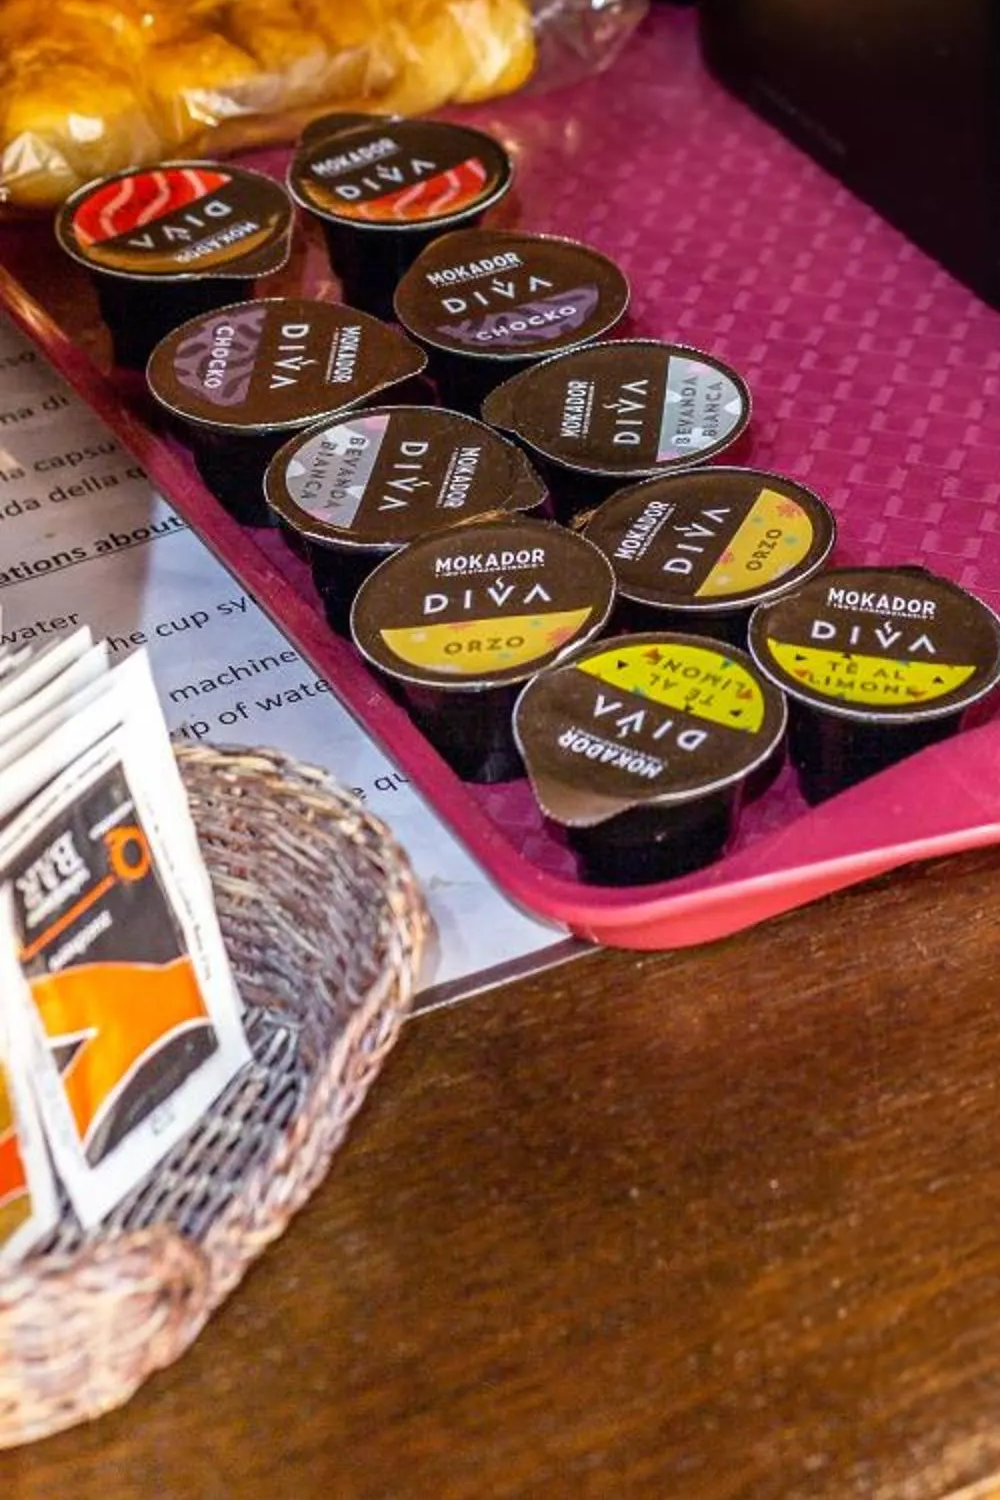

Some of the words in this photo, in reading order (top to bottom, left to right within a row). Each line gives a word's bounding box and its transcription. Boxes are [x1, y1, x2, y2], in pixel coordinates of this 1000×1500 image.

[311, 137, 399, 177] MOKADOR
[335, 158, 437, 200] DIVA
[129, 198, 233, 251] DIVA
[425, 251, 522, 286] MOKADOR
[440, 274, 554, 315] DIVA
[475, 304, 578, 343] CHOCKO
[203, 325, 236, 390] CHOCKO
[269, 322, 318, 391] DIVA
[331, 324, 363, 385] MOKADOR
[560, 379, 590, 439] MOKADOR
[602, 378, 650, 446] DIVA
[675, 375, 699, 446] BEVANDA
[701, 380, 724, 438] BIANCA
[48, 474, 119, 504] della
[299, 439, 331, 501] BIANCA
[322, 435, 368, 510] BEVANDA
[377, 440, 432, 512] DIVA
[442, 446, 483, 510] MOKADOR
[93, 515, 186, 554] about
[613, 499, 671, 562] MOKADOR
[663, 506, 732, 576] DIVA
[745, 528, 783, 572] ORZO
[434, 547, 545, 574] MOKADOR
[423, 577, 553, 615] DIVA
[827, 586, 937, 616] MOKADOR
[104, 629, 149, 655] he
[155, 609, 210, 639] cup
[443, 633, 526, 656] ORZO
[810, 619, 938, 654] DIVA
[169, 650, 301, 704] machine
[649, 672, 679, 691] AL
[872, 666, 905, 682] AL
[218, 702, 249, 726] of
[592, 693, 708, 752] DIVA
[556, 728, 664, 780] MOKADOR
